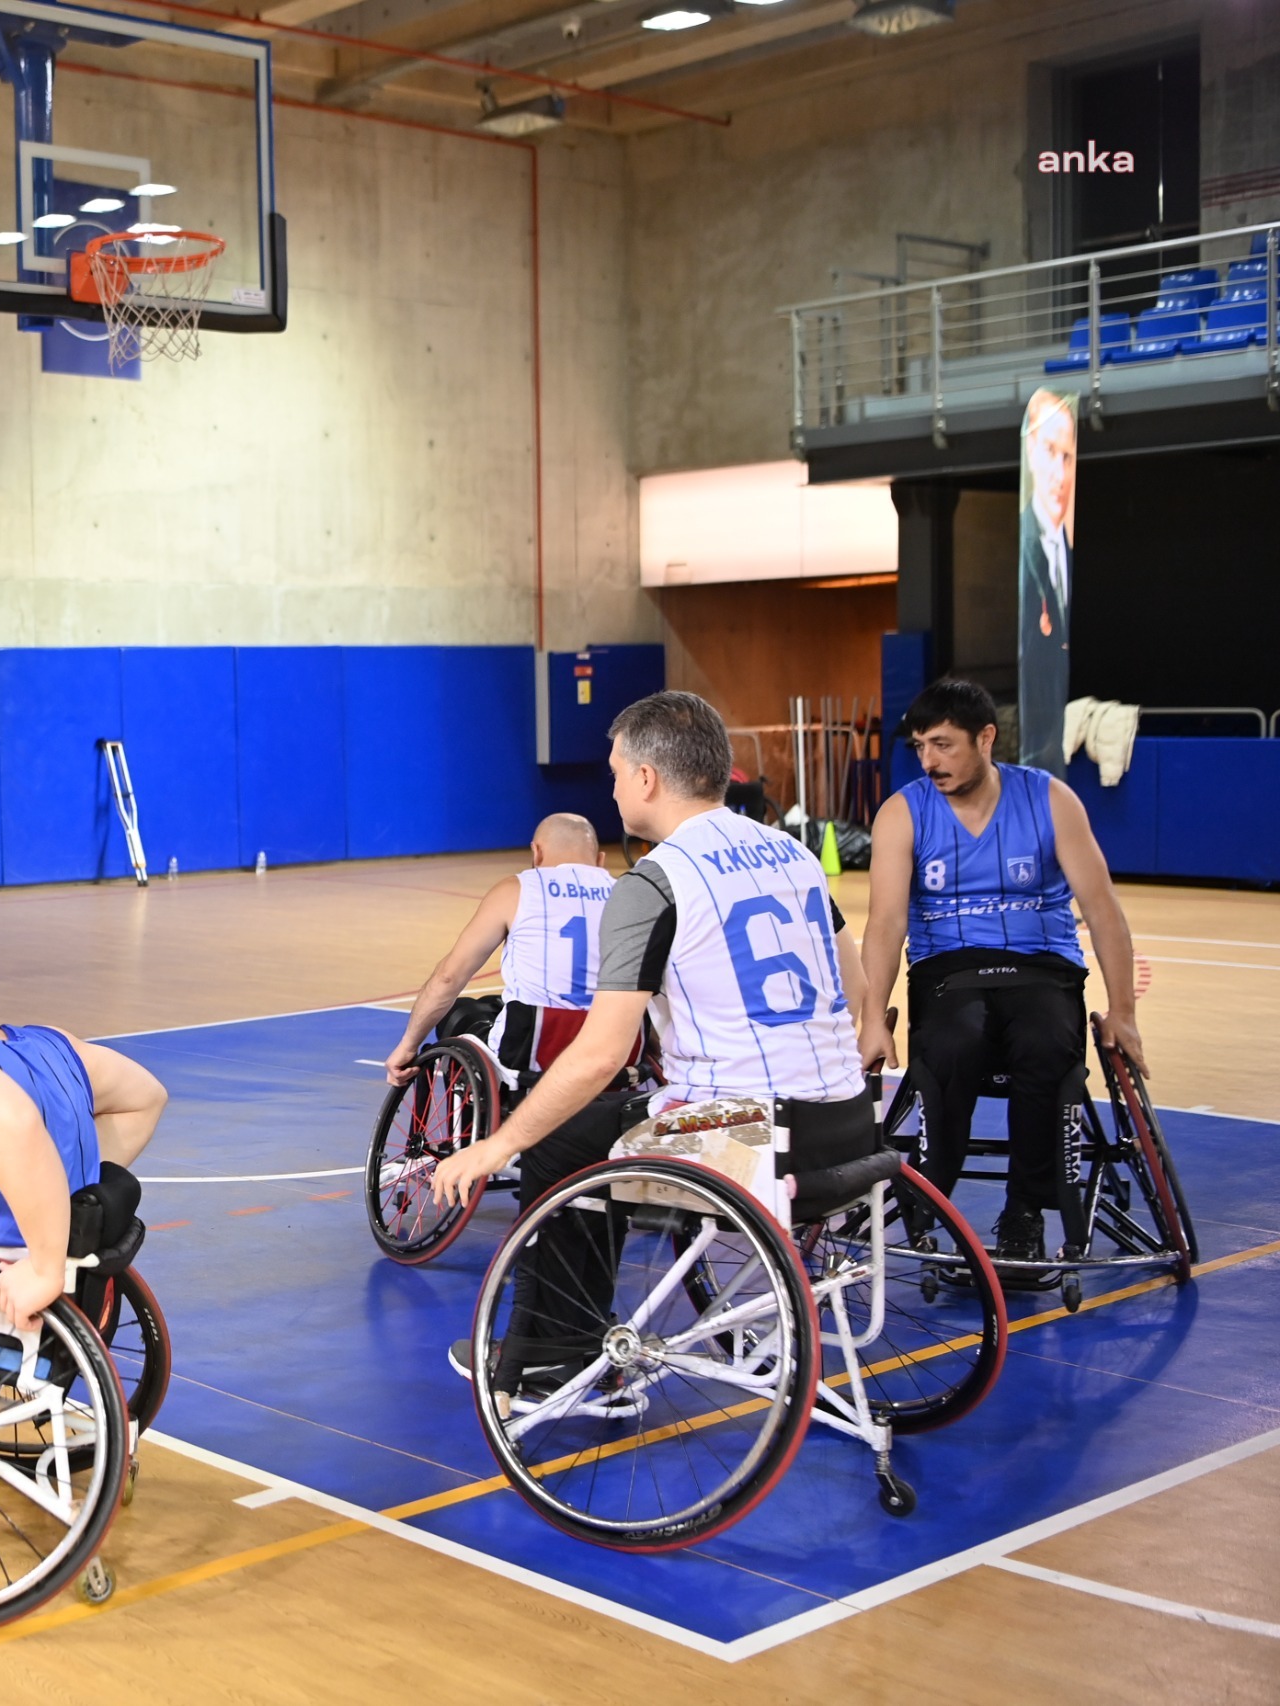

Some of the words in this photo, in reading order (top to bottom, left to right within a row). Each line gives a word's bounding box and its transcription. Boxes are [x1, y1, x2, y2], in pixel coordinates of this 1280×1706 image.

[701, 837, 806, 875] Y.KÜÇÜK
[924, 860, 946, 891] 8
[722, 886, 848, 1028] 61
[978, 966, 1018, 975] EXTRA
[677, 1107, 766, 1134] Maxima
[1063, 1124, 1073, 1184] WHEELCHAIR
